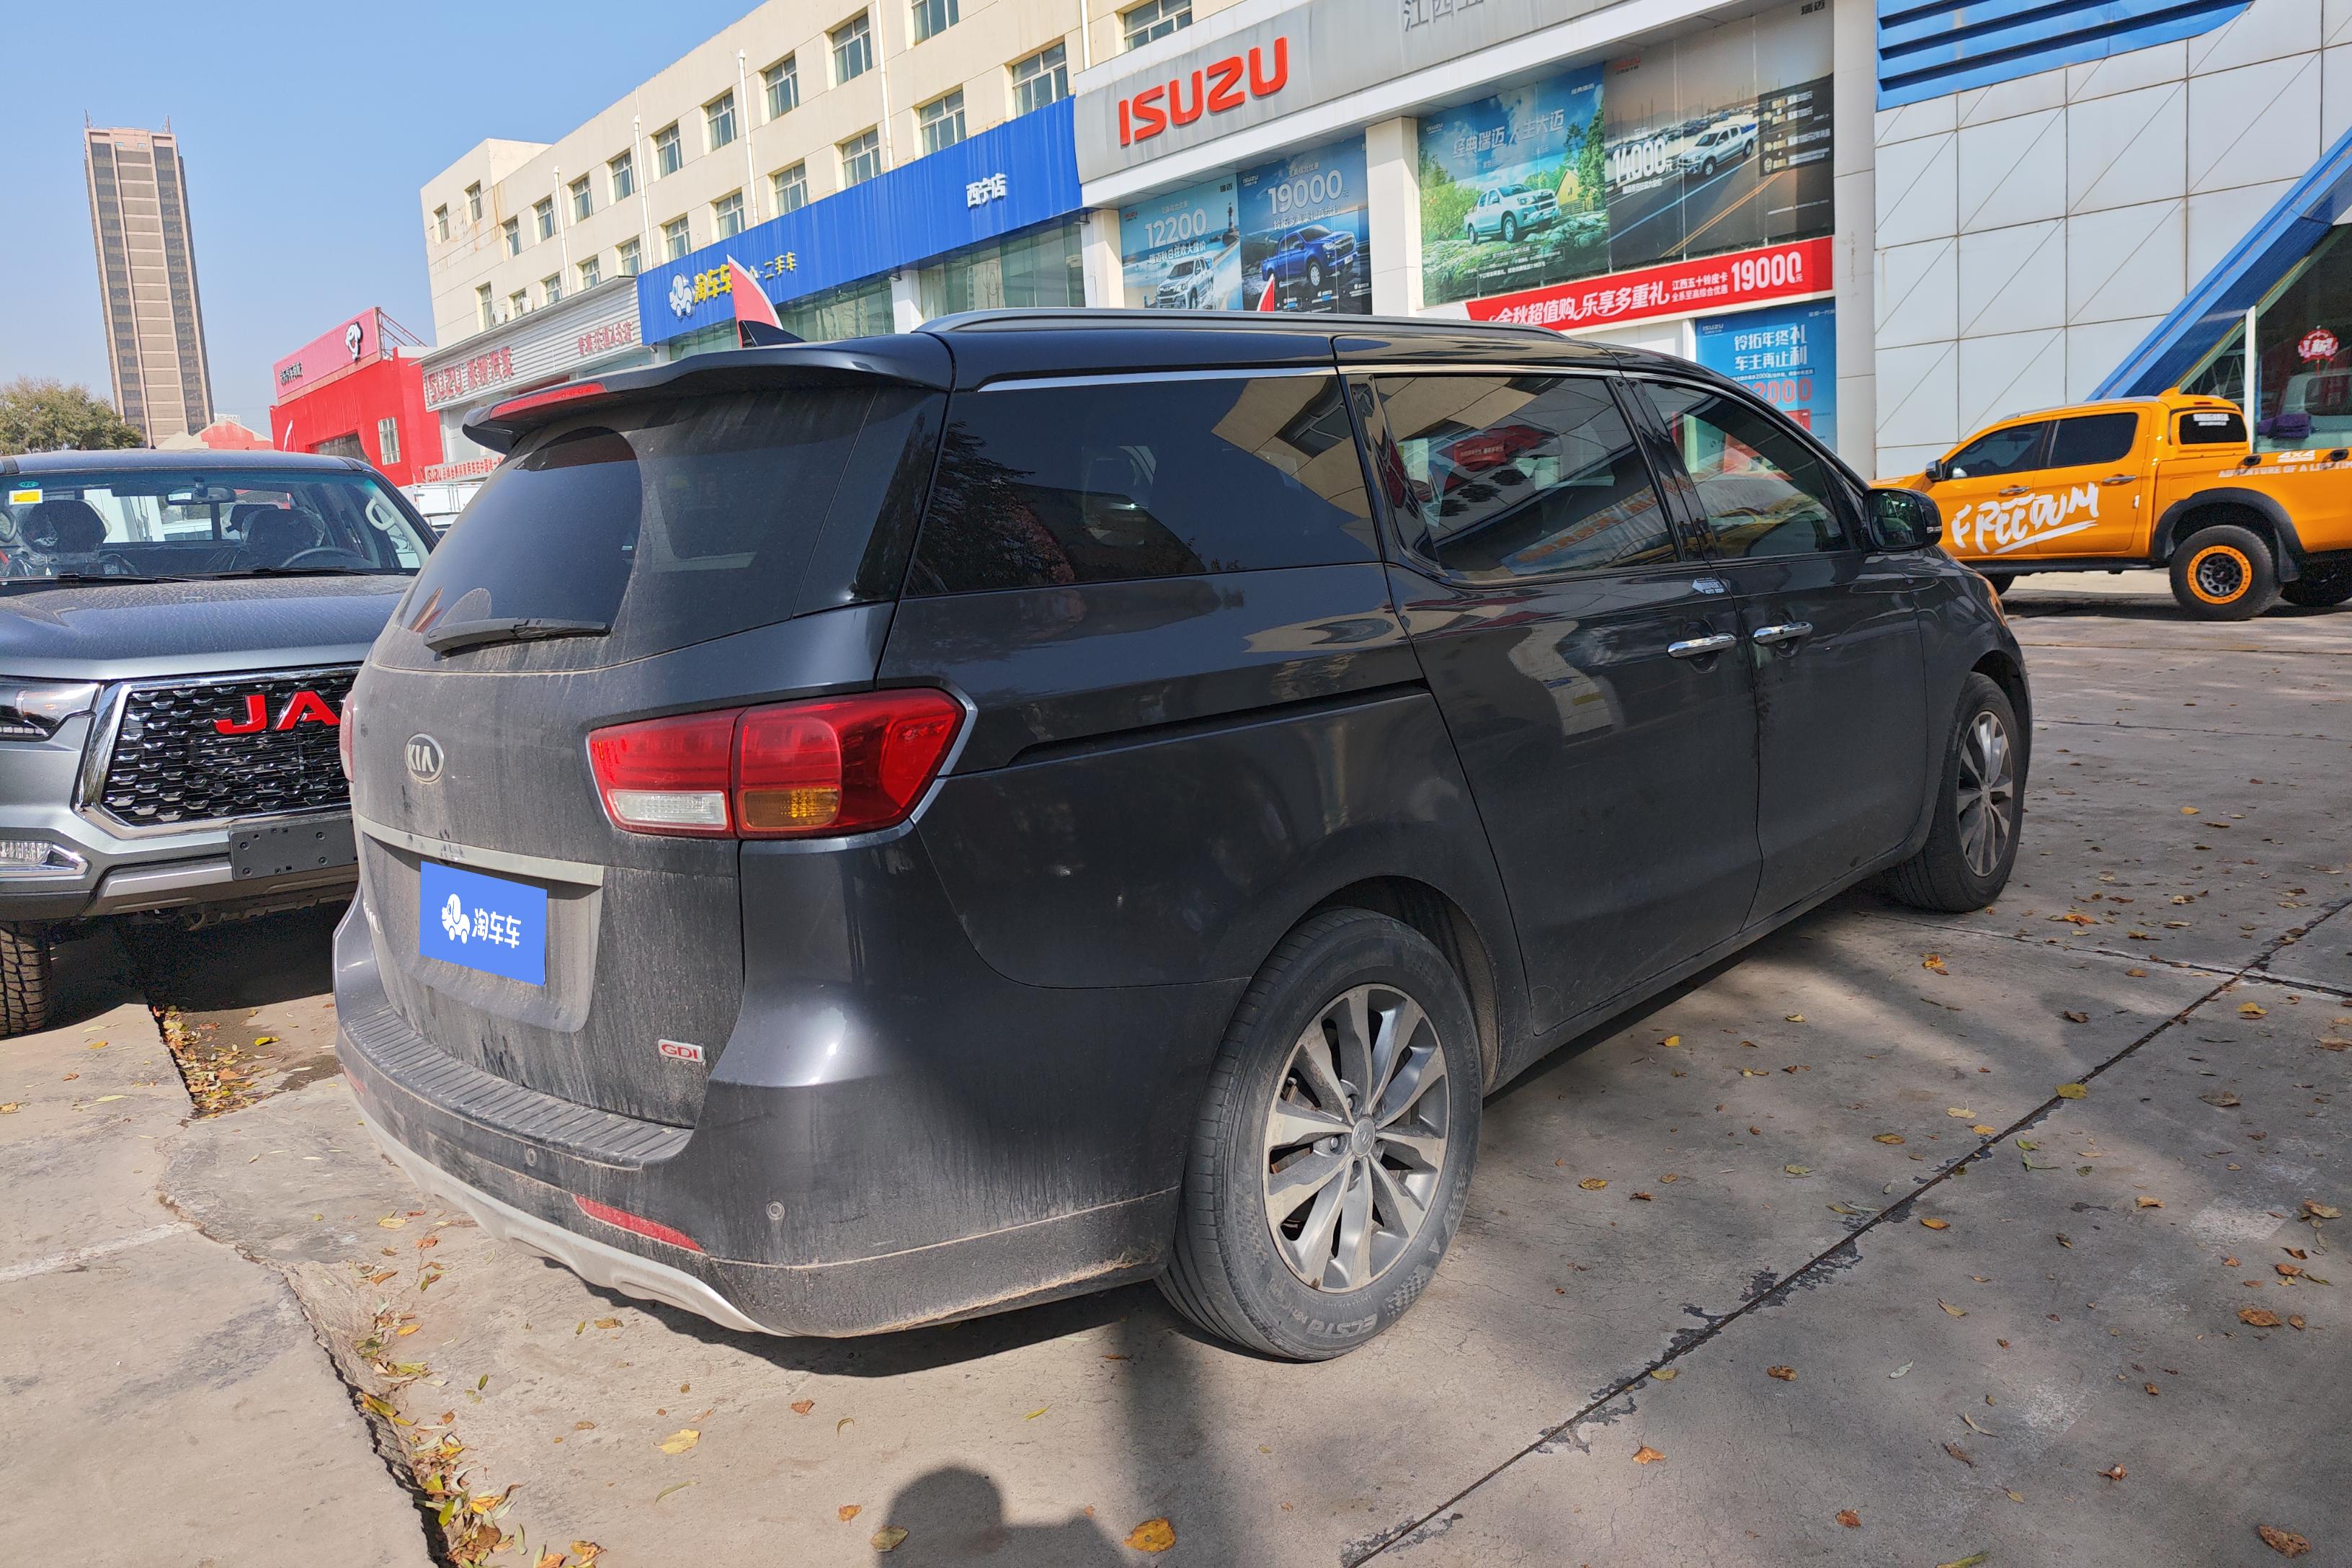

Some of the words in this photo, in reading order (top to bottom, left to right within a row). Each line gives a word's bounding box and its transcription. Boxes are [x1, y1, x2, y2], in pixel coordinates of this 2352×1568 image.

[1118, 36, 1288, 147] ISUZU
[1453, 126, 1505, 159] 经典瑞迈
[1506, 109, 1565, 146] 人生大迈
[1242, 174, 1259, 184] ISUZU
[1613, 138, 1666, 184] 14000
[966, 172, 1008, 208] 西宁店
[1268, 169, 1343, 215] 19000
[1145, 208, 1207, 249] 12200
[693, 264, 732, 304] 淘车车
[1672, 271, 1728, 290] 江西五十铃皮卡
[1731, 251, 1801, 293] 19000
[1796, 273, 1803, 282] 元
[1489, 296, 1576, 325] 金秋超值购
[1575, 280, 1671, 321] 乐享多重礼
[1672, 285, 1728, 303] 全系至高综合优惠
[1734, 324, 1807, 352] 铃拓年终礼
[424, 363, 464, 404] ISUZU
[2283, 465, 2297, 474] OF
[2299, 463, 2307, 473] A
[1951, 482, 2099, 554] FREEDOM
[407, 744, 435, 772] KIA
[662, 1043, 698, 1059] GDI
